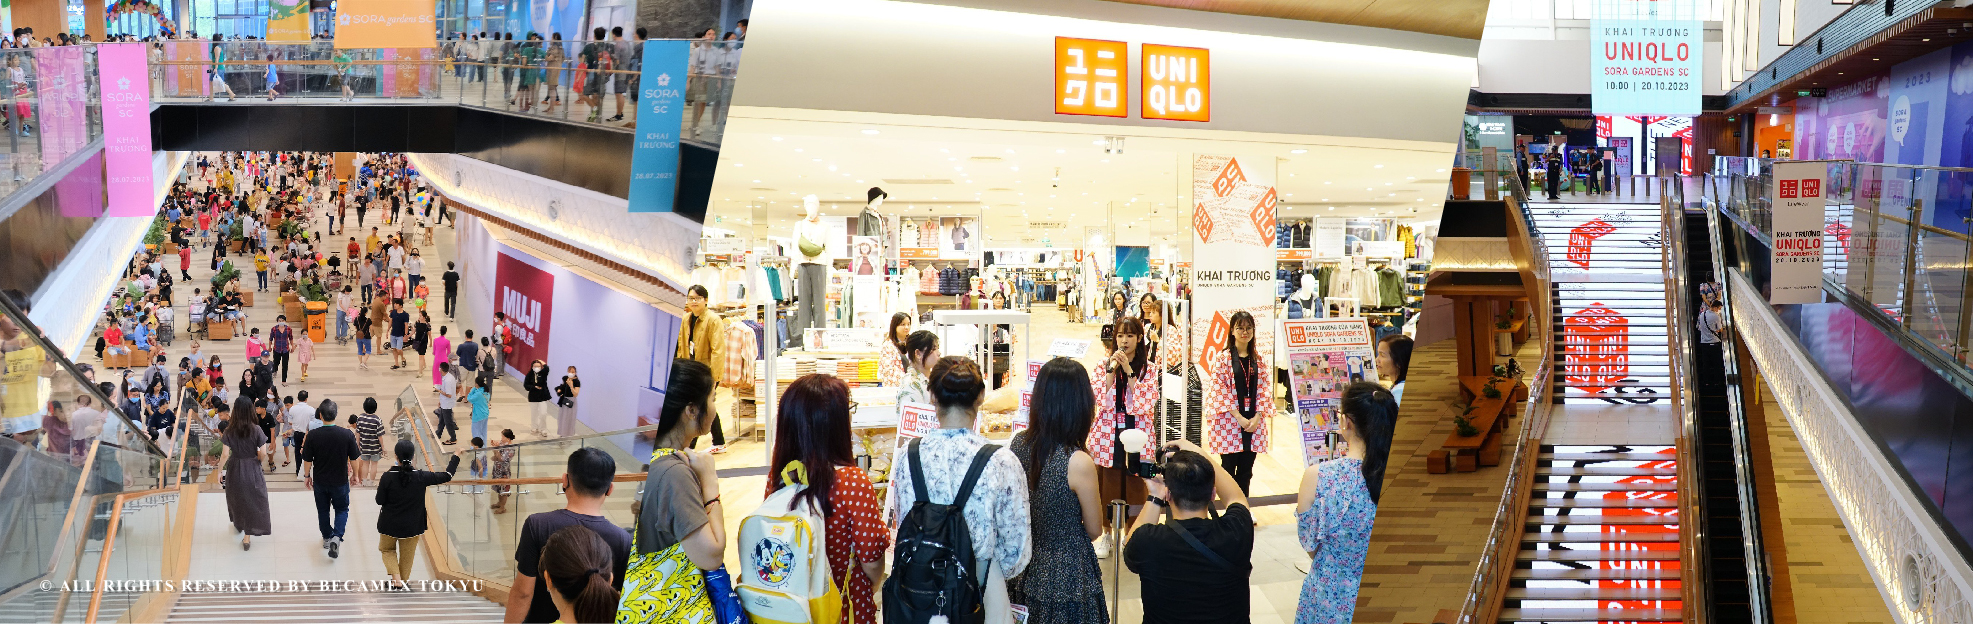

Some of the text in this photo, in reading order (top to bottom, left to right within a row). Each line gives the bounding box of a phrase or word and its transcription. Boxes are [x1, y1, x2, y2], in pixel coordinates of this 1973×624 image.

[353, 14, 434, 26] SORA gardens SC
[1605, 28, 1633, 36] KHAI
[1605, 42, 1689, 64] UNIQLO
[1150, 54, 1197, 83] UNI
[1604, 67, 1689, 76] SORA GARDENS SC
[1905, 71, 1931, 88] 2023
[1606, 82, 1629, 90] 10:00
[1641, 82, 1689, 91] 20.10.2023
[1827, 76, 1878, 101] SUPERMARKET
[106, 92, 143, 102] SORA
[645, 89, 680, 99] SORA
[1150, 84, 1201, 115] QLO
[118, 109, 134, 118] SC
[653, 106, 668, 114] SC
[116, 136, 139, 144] KHAI
[1803, 188, 1818, 196] QLO
[1197, 208, 1211, 229] UNI
[1776, 238, 1821, 252] UNIQLO
[1197, 270, 1223, 281] KHAI
[1226, 269, 1271, 281] TRƯƠNG
[502, 285, 542, 333] MUJI
